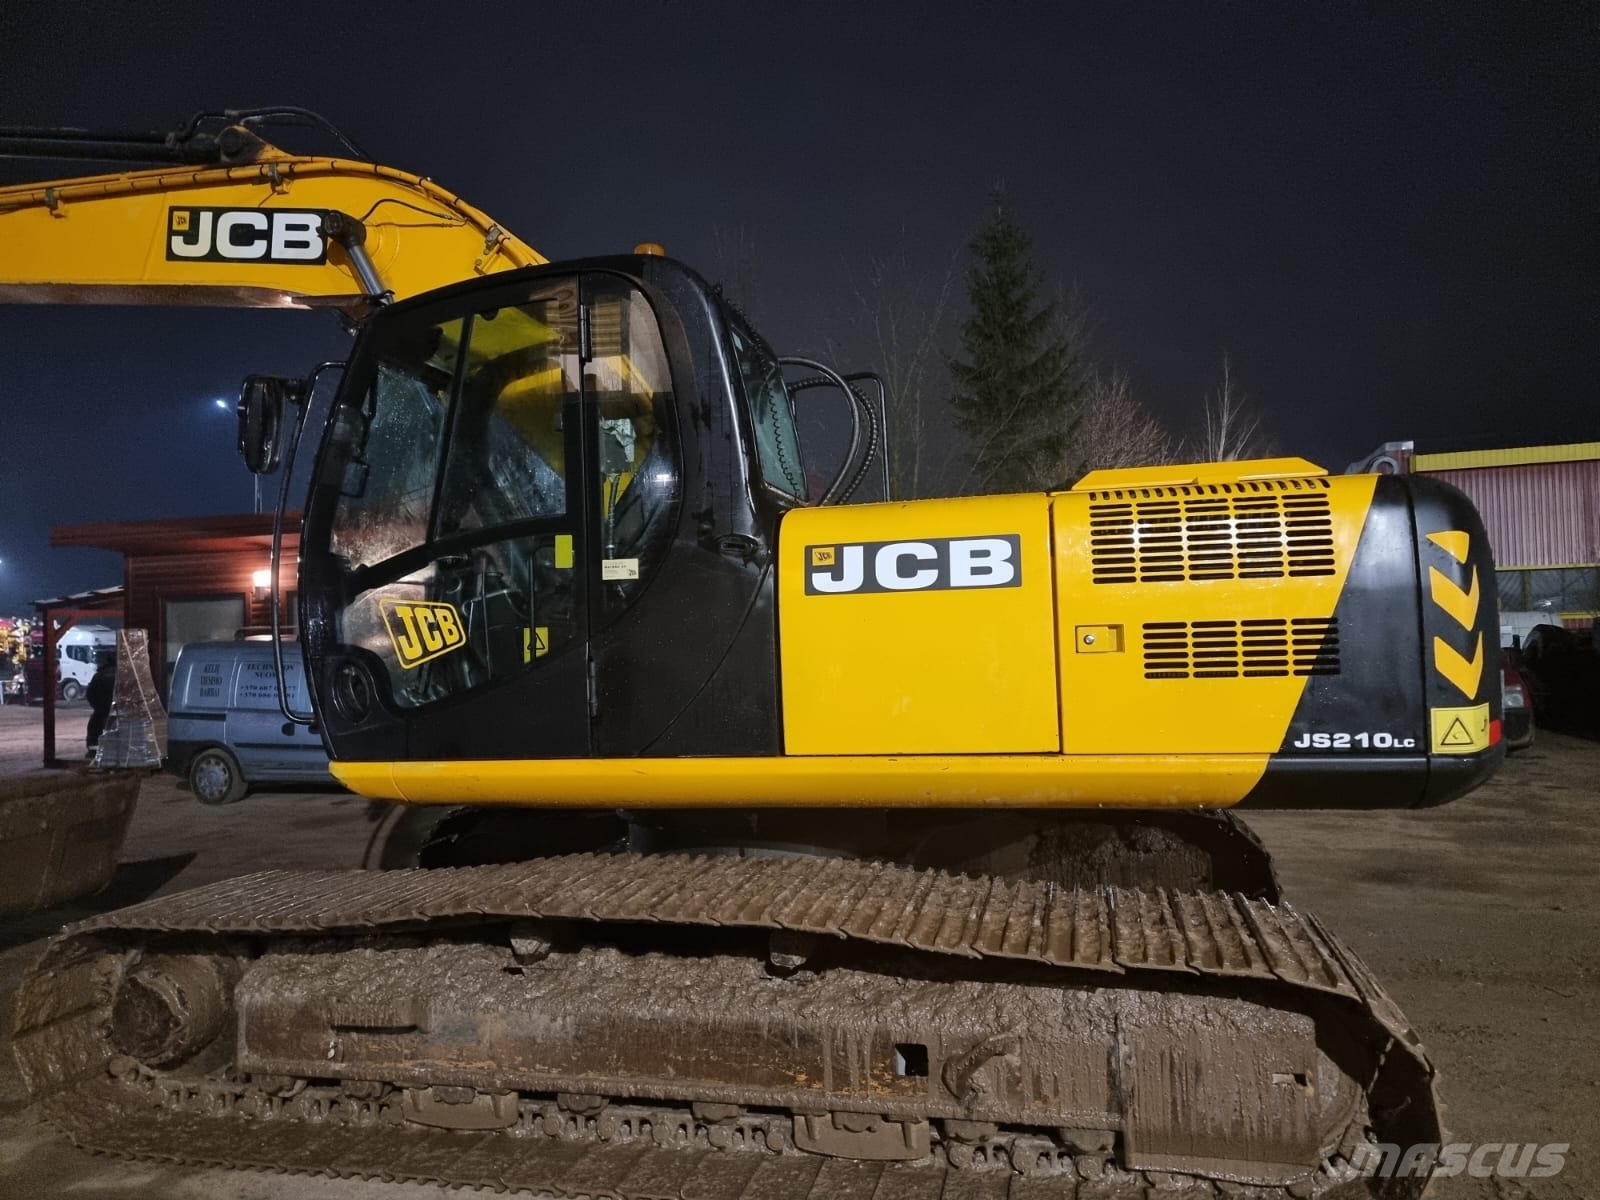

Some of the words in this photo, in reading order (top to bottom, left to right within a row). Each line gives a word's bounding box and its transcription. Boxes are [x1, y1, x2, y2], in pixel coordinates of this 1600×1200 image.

[170, 210, 324, 260] JCB
[812, 538, 1015, 593] JCB
[395, 606, 460, 660] JCB
